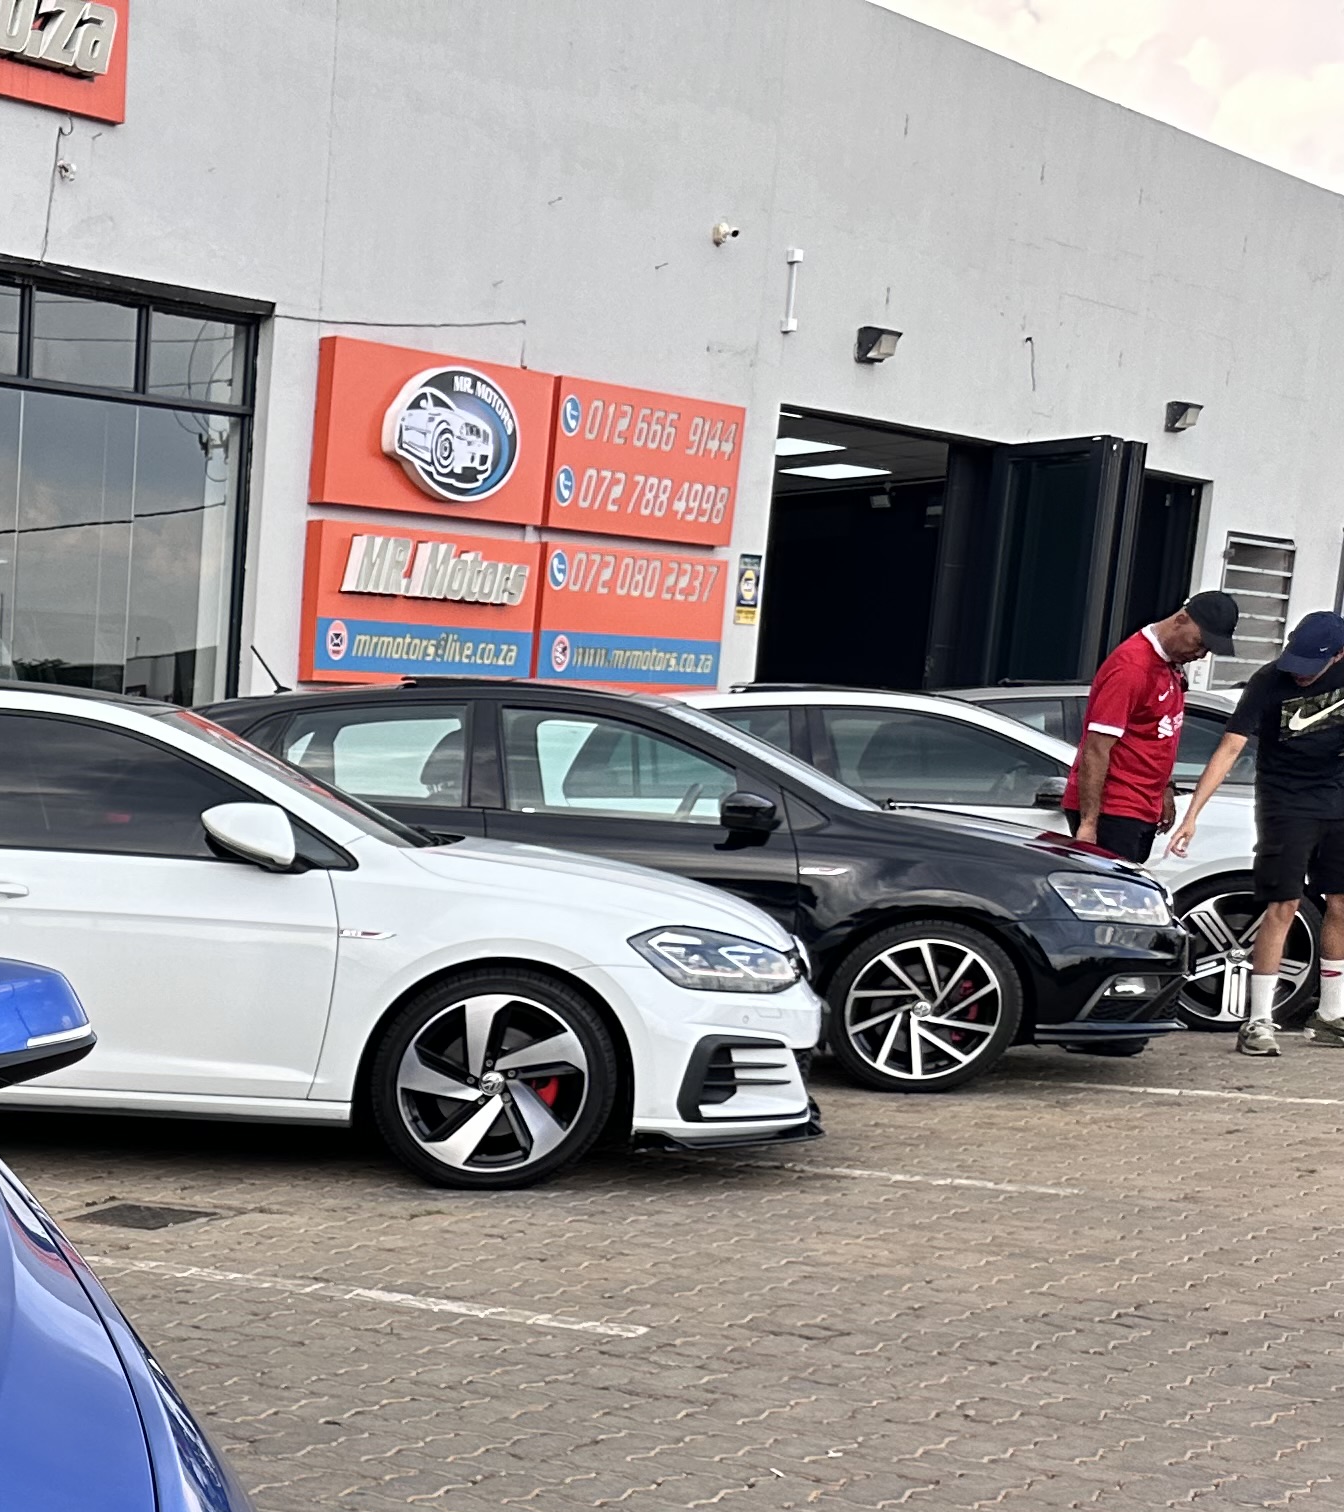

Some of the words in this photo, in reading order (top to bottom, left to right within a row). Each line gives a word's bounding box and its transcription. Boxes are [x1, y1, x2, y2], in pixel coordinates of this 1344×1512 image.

[453, 375, 473, 394] MR.
[475, 381, 514, 435] MOTORS
[584, 400, 633, 444] 012
[633, 408, 680, 452] 666
[685, 416, 738, 461] 9144
[577, 467, 627, 512] 072
[627, 473, 673, 517] 788
[672, 481, 730, 524] 4998
[341, 535, 412, 595] MR.
[412, 541, 529, 605] Motors
[568, 552, 616, 594] 072
[616, 556, 663, 598] 080
[662, 561, 719, 602] 2237
